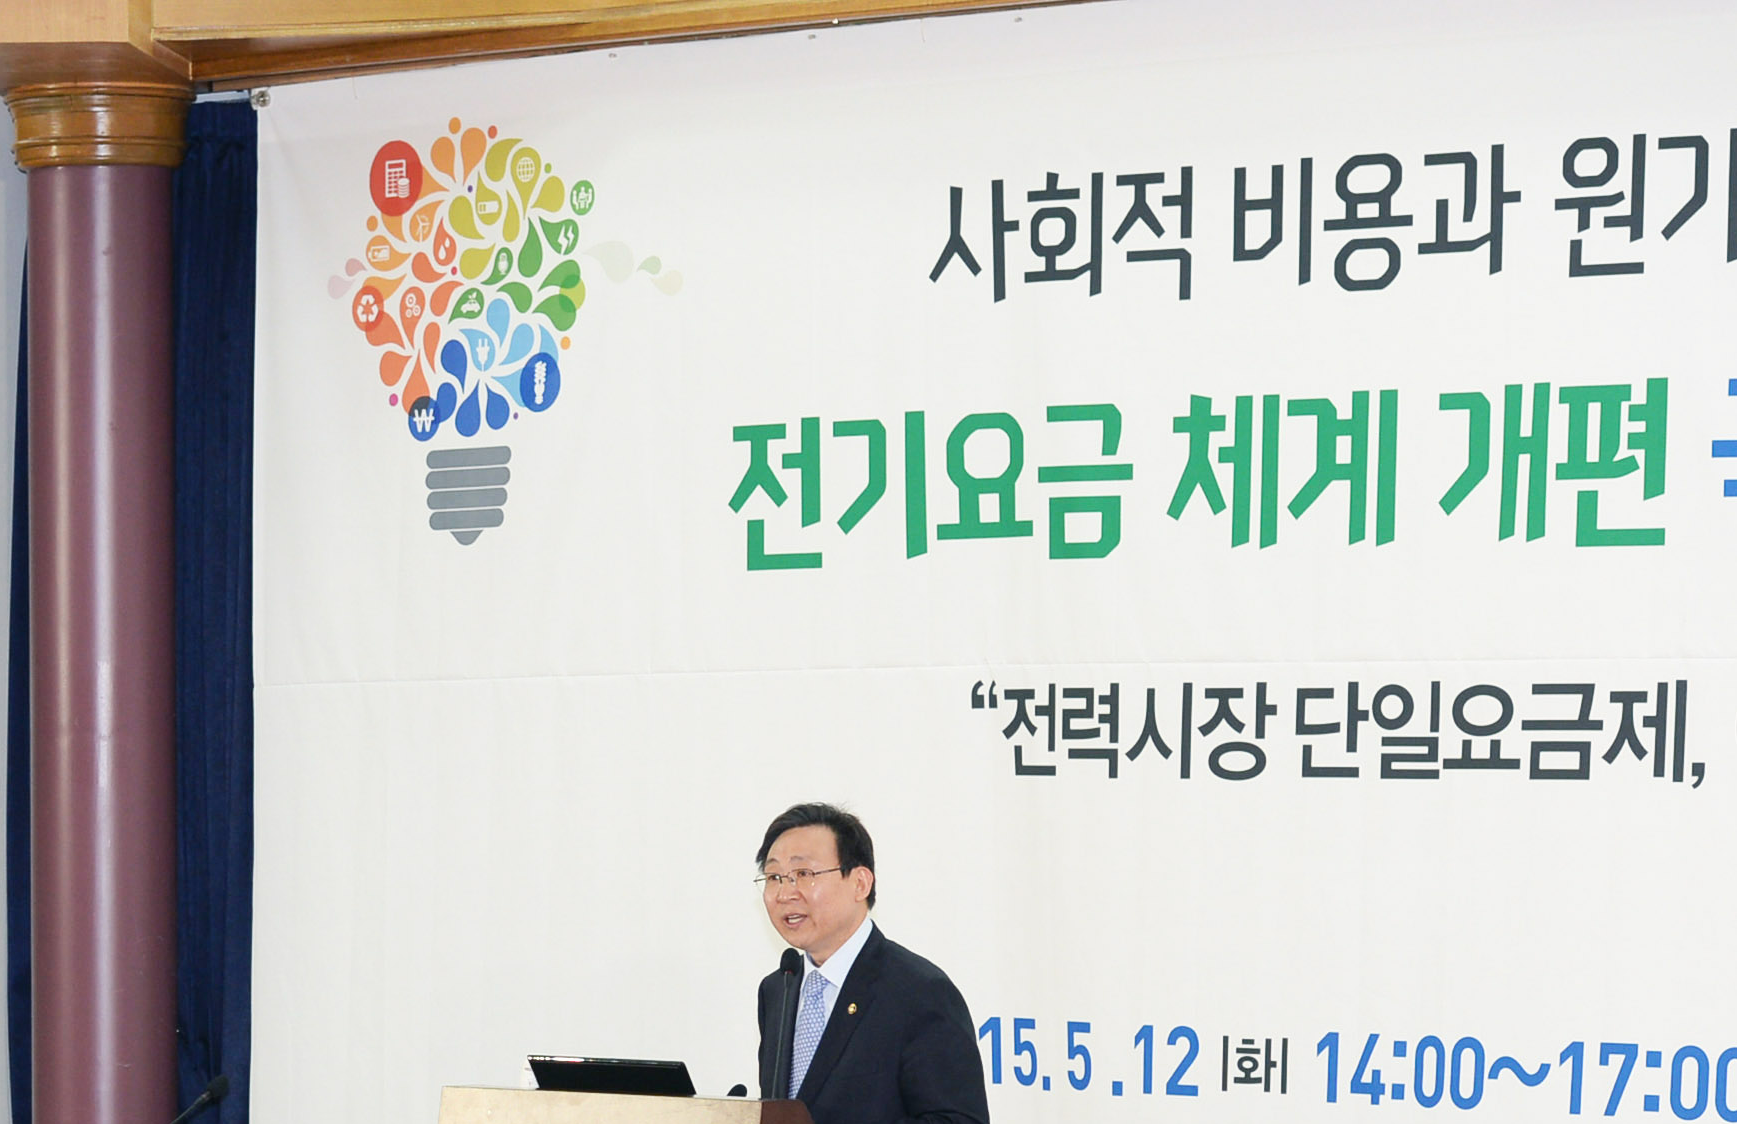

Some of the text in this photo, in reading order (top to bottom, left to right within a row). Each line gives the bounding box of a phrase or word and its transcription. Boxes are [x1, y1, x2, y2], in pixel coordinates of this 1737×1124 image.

[929, 166, 1193, 303] 사회적
[1233, 144, 1521, 291] 비용과
[728, 404, 1133, 571] 전기요금
[1167, 389, 1398, 549] 체계
[1439, 377, 1668, 547] 개편
[1295, 680, 1705, 789] 단일요금제,
